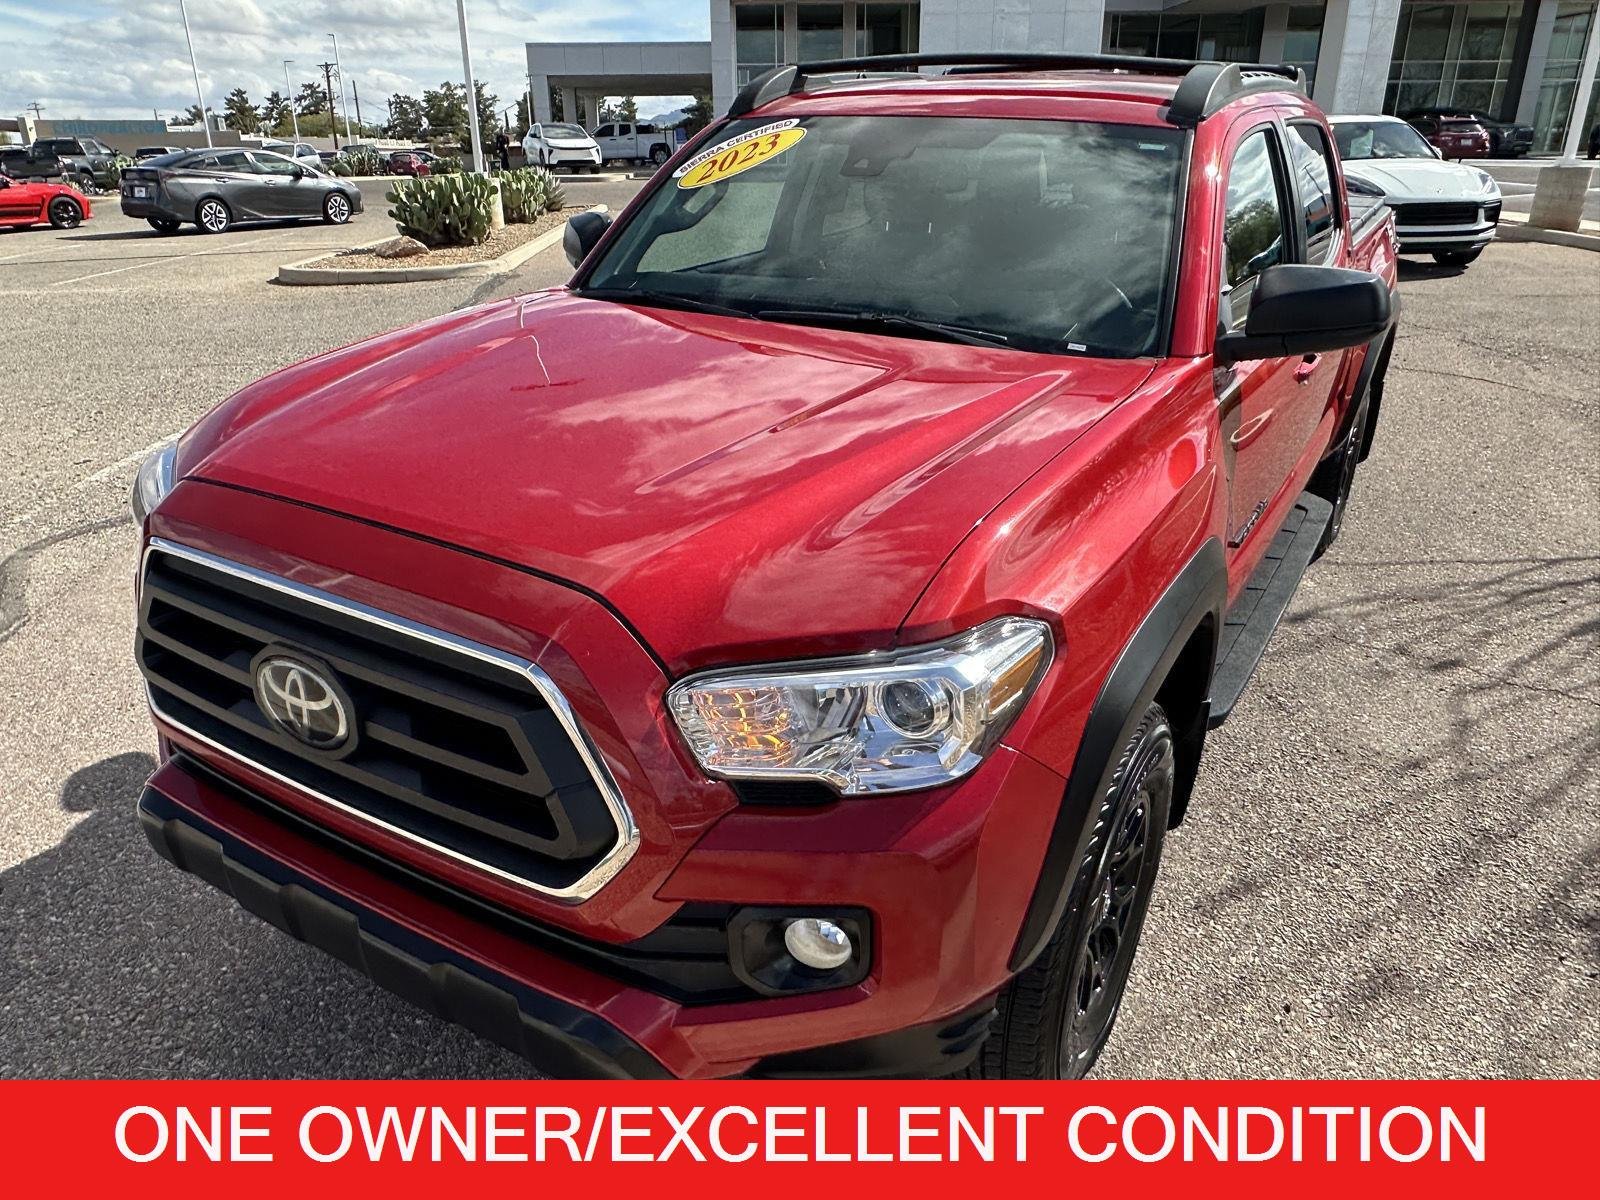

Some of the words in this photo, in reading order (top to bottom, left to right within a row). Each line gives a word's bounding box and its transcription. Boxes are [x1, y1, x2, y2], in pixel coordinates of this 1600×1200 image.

[680, 146, 724, 173] SIERRA
[727, 120, 793, 146] CERTIFIED
[697, 133, 781, 183] 2023
